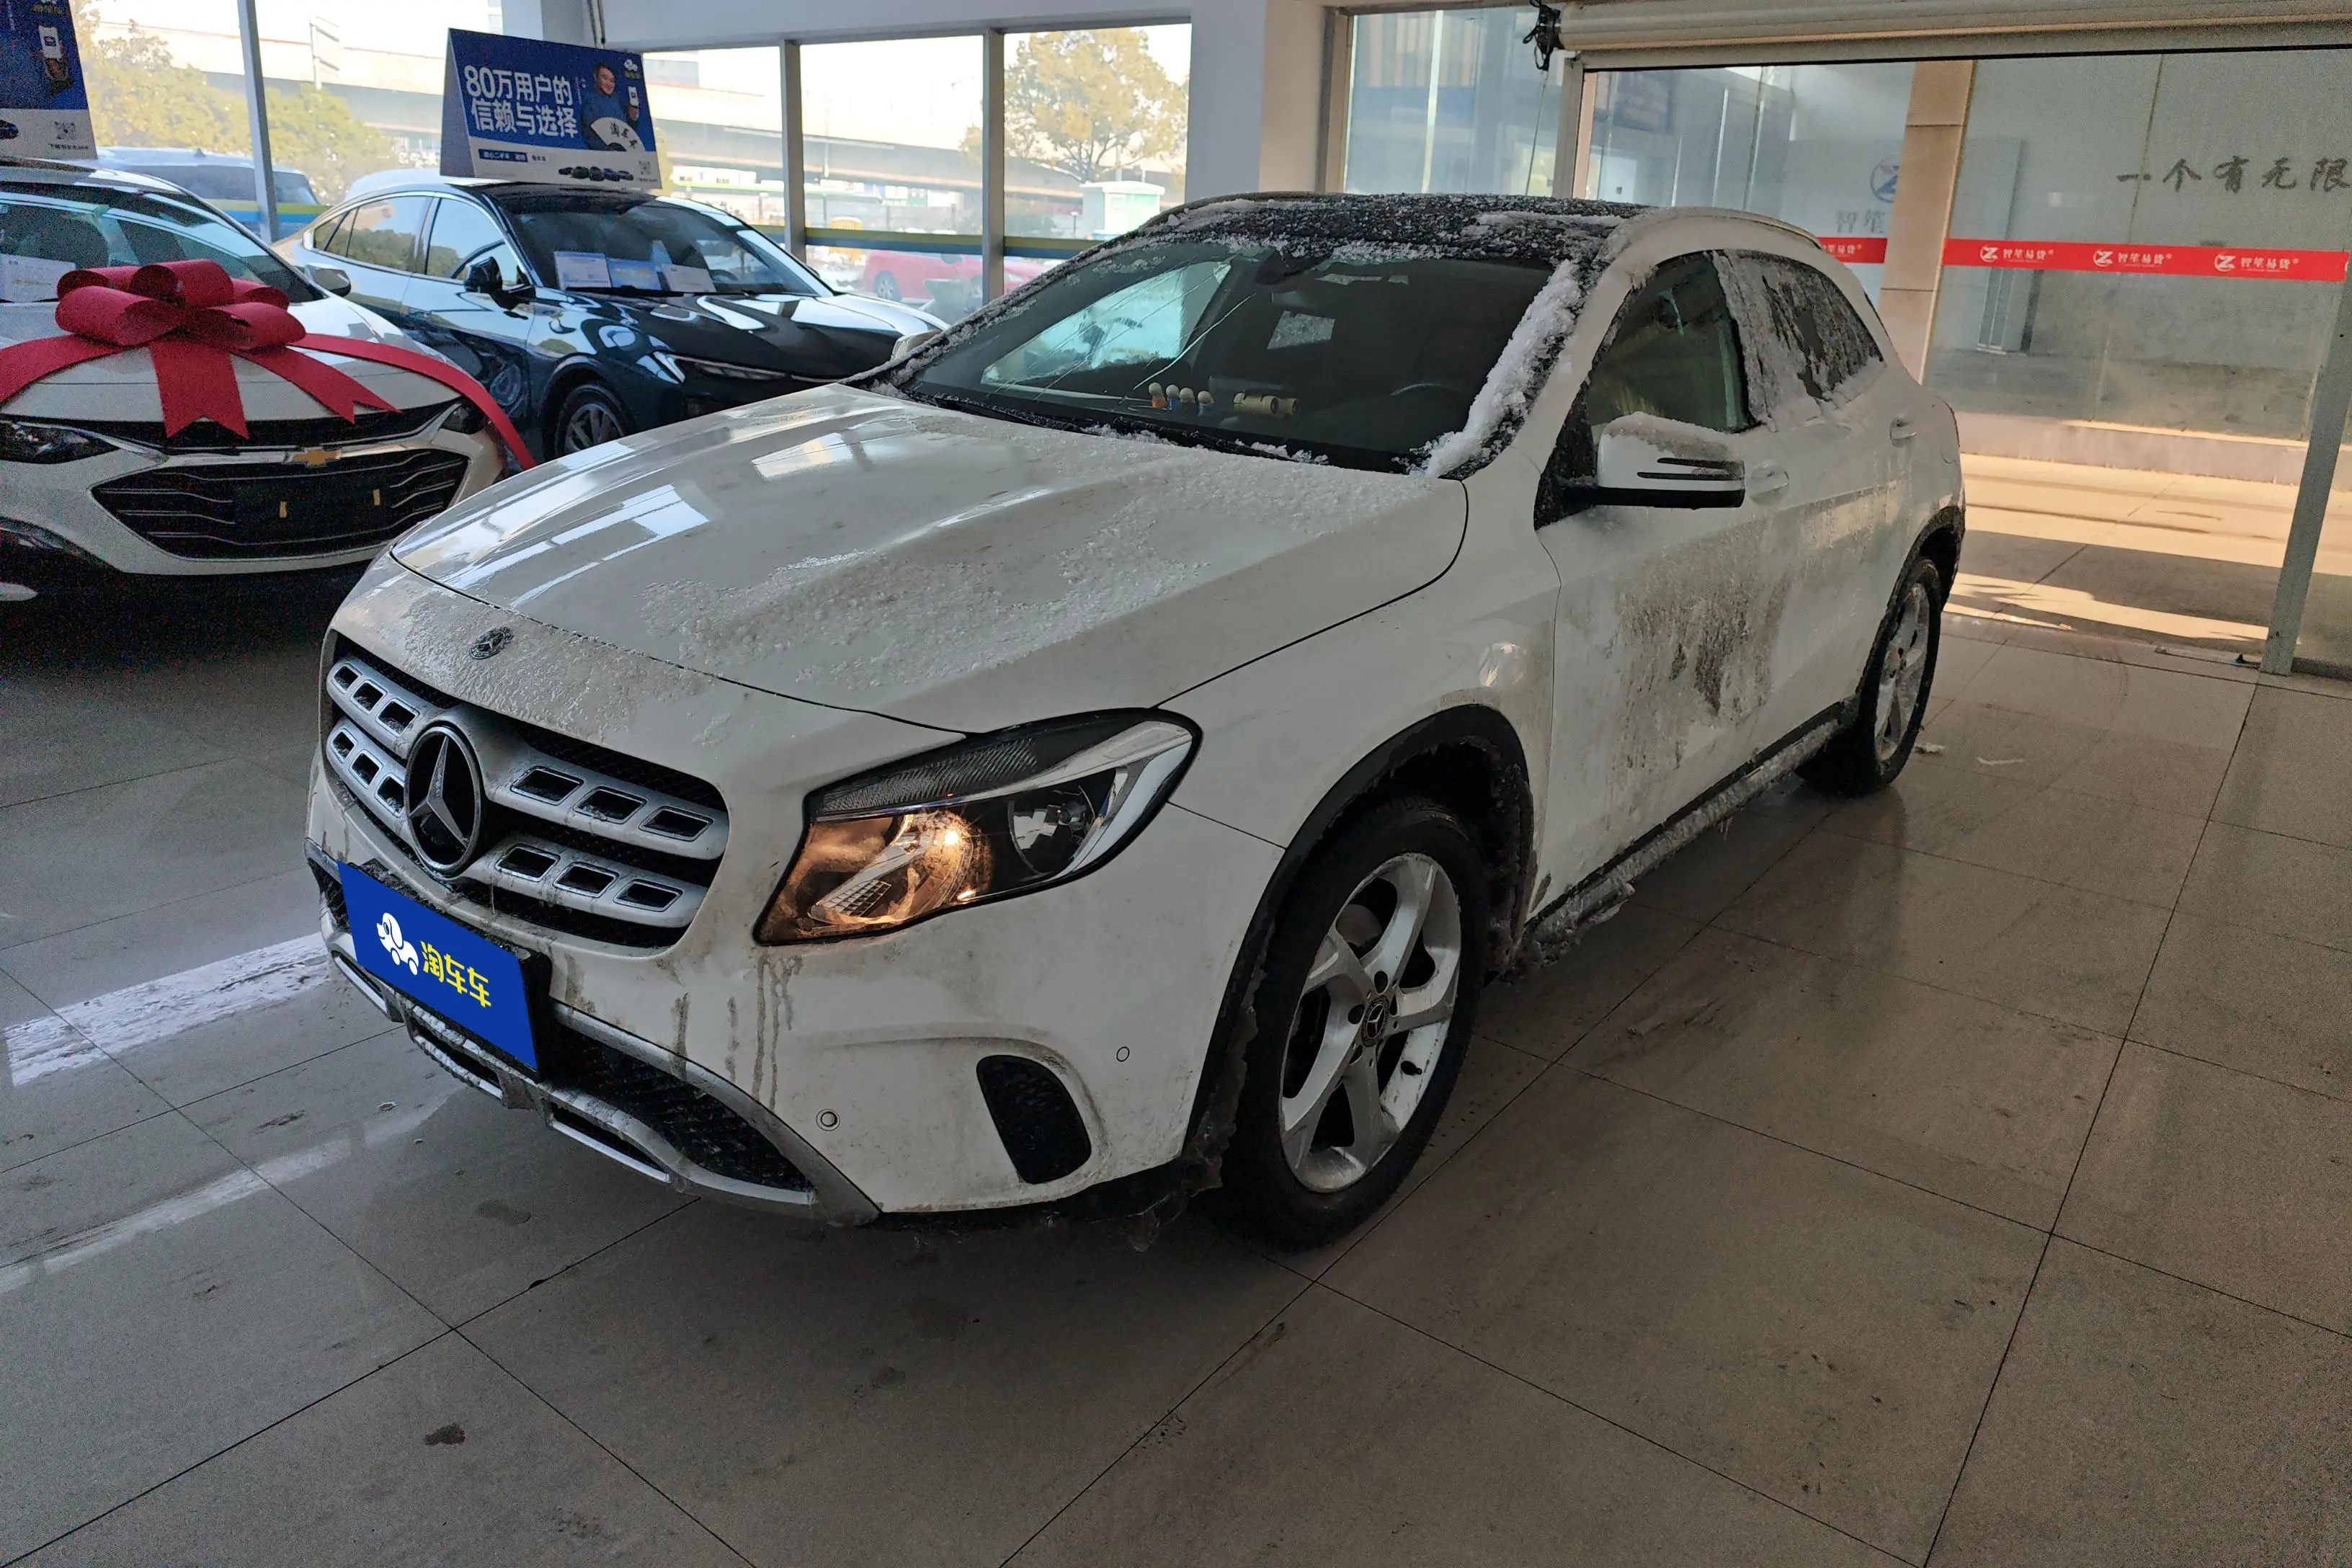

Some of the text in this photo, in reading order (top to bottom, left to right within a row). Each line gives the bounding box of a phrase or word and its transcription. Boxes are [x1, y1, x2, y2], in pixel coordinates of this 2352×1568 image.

[464, 65, 573, 105] 80万用户的
[471, 98, 578, 138] 信赖与选择
